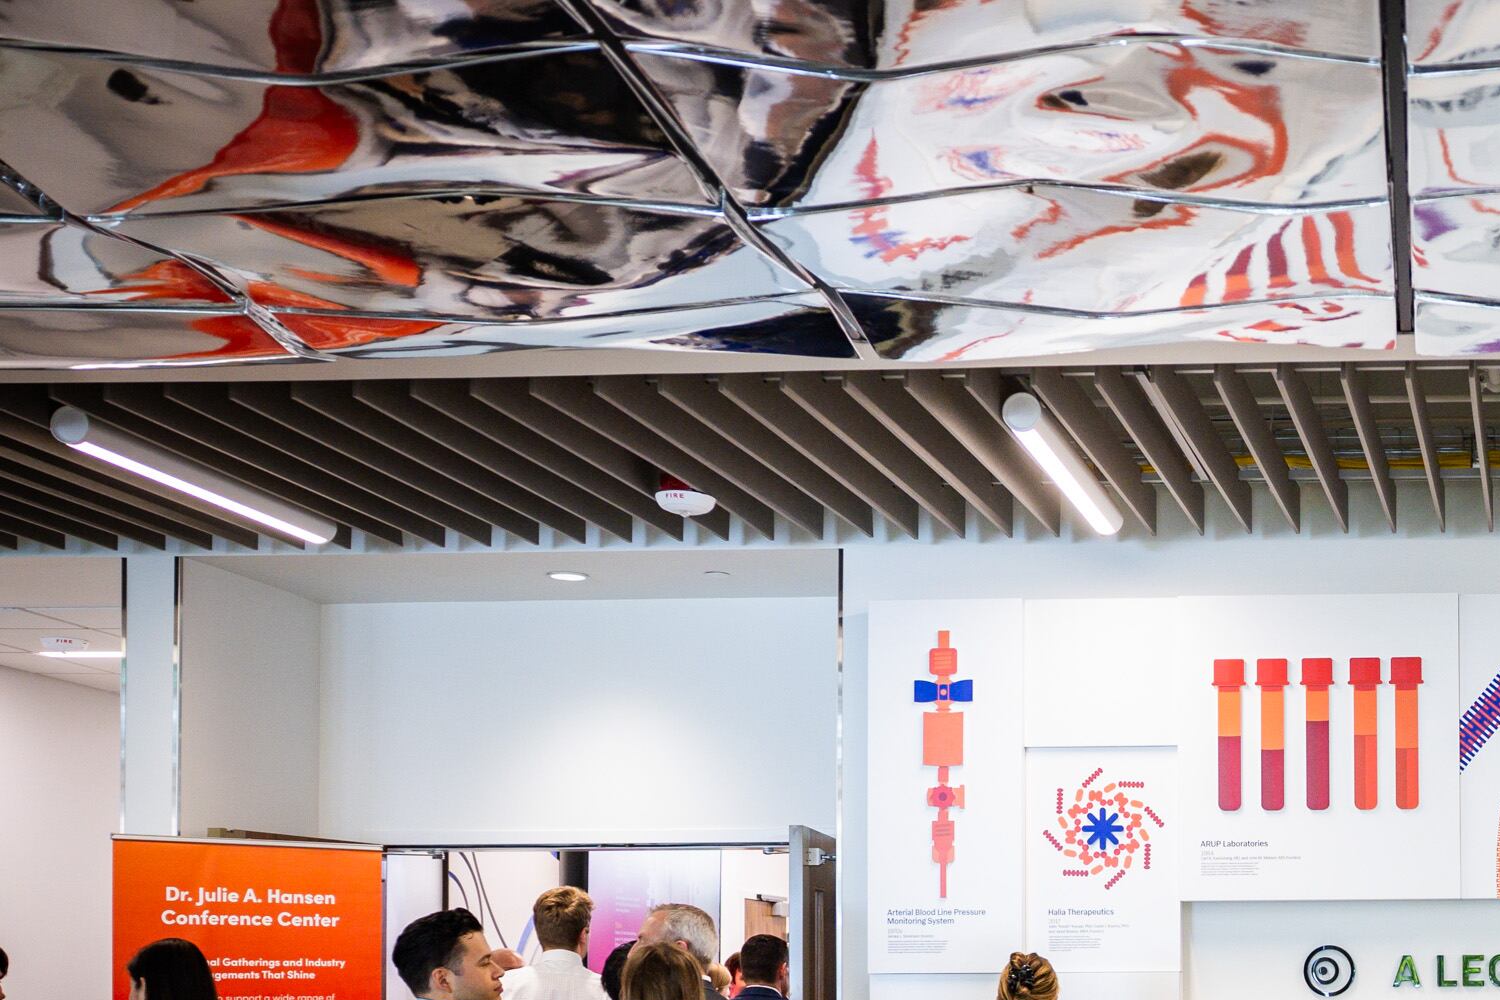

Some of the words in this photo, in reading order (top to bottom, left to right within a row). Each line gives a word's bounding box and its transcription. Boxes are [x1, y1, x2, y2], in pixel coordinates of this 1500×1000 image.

[1223, 839, 1269, 847] Laboratories
[165, 886, 193, 902] Dr.
[195, 886, 240, 906] Julie
[243, 888, 263, 903] A.
[267, 889, 336, 905] Hansen
[887, 908, 914, 916] Arterial
[915, 908, 936, 916] Blood
[937, 908, 952, 916] Line
[954, 908, 986, 916] Pressure
[1048, 908, 1066, 916] Halia
[1068, 908, 1115, 917] Therapeutics
[160, 909, 273, 927] Conference
[277, 911, 341, 928] Center
[887, 917, 926, 926] Monitoring
[927, 917, 955, 926] System
[222, 957, 280, 970] Gatherings
[282, 958, 303, 967] and
[305, 958, 346, 969] Industry
[212, 971, 260, 981] gements
[261, 970, 285, 980] That
[287, 970, 316, 980] Shine
[1392, 954, 1422, 987] A
